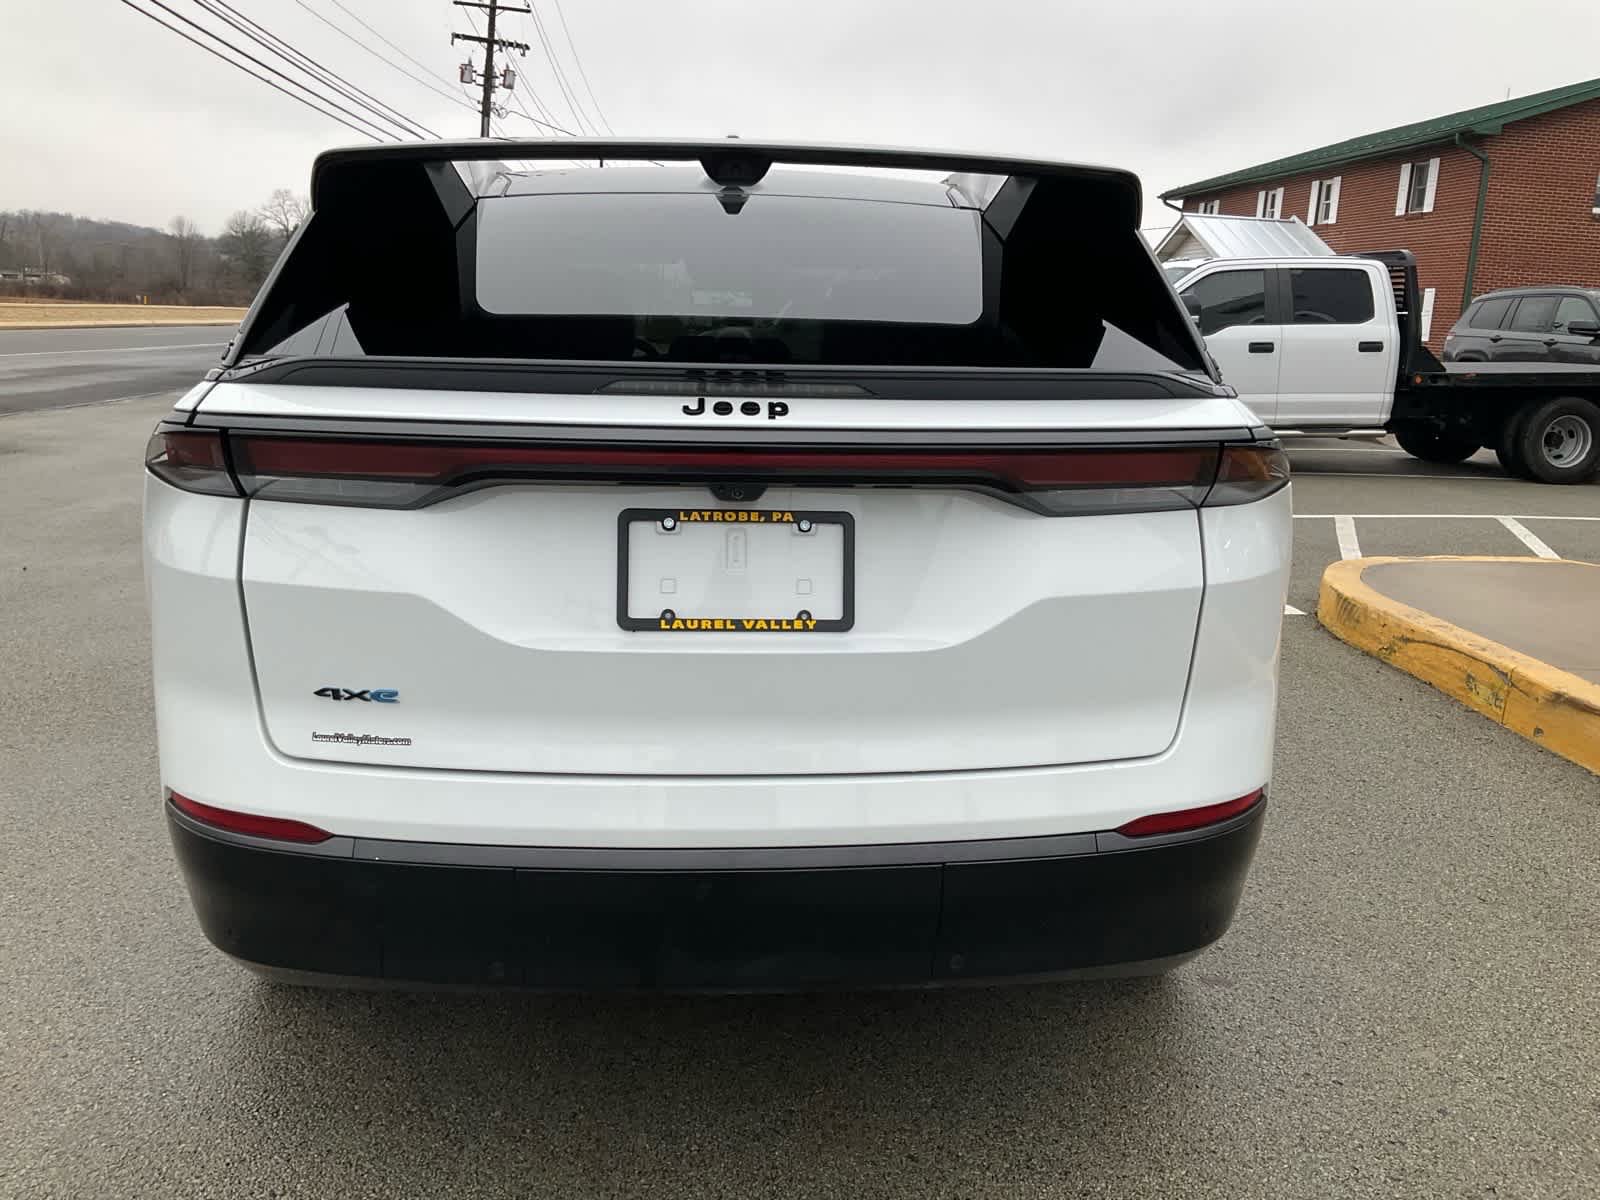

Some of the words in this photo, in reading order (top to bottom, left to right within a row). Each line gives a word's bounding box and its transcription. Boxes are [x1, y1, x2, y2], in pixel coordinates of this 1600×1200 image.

[682, 397, 789, 419] Jeep
[679, 511, 765, 522] LATROBE,
[772, 512, 794, 522] PA
[660, 619, 735, 630] LAUREL
[742, 619, 817, 631] VALLEY
[312, 731, 412, 746] LaurelValleyMotors.com
